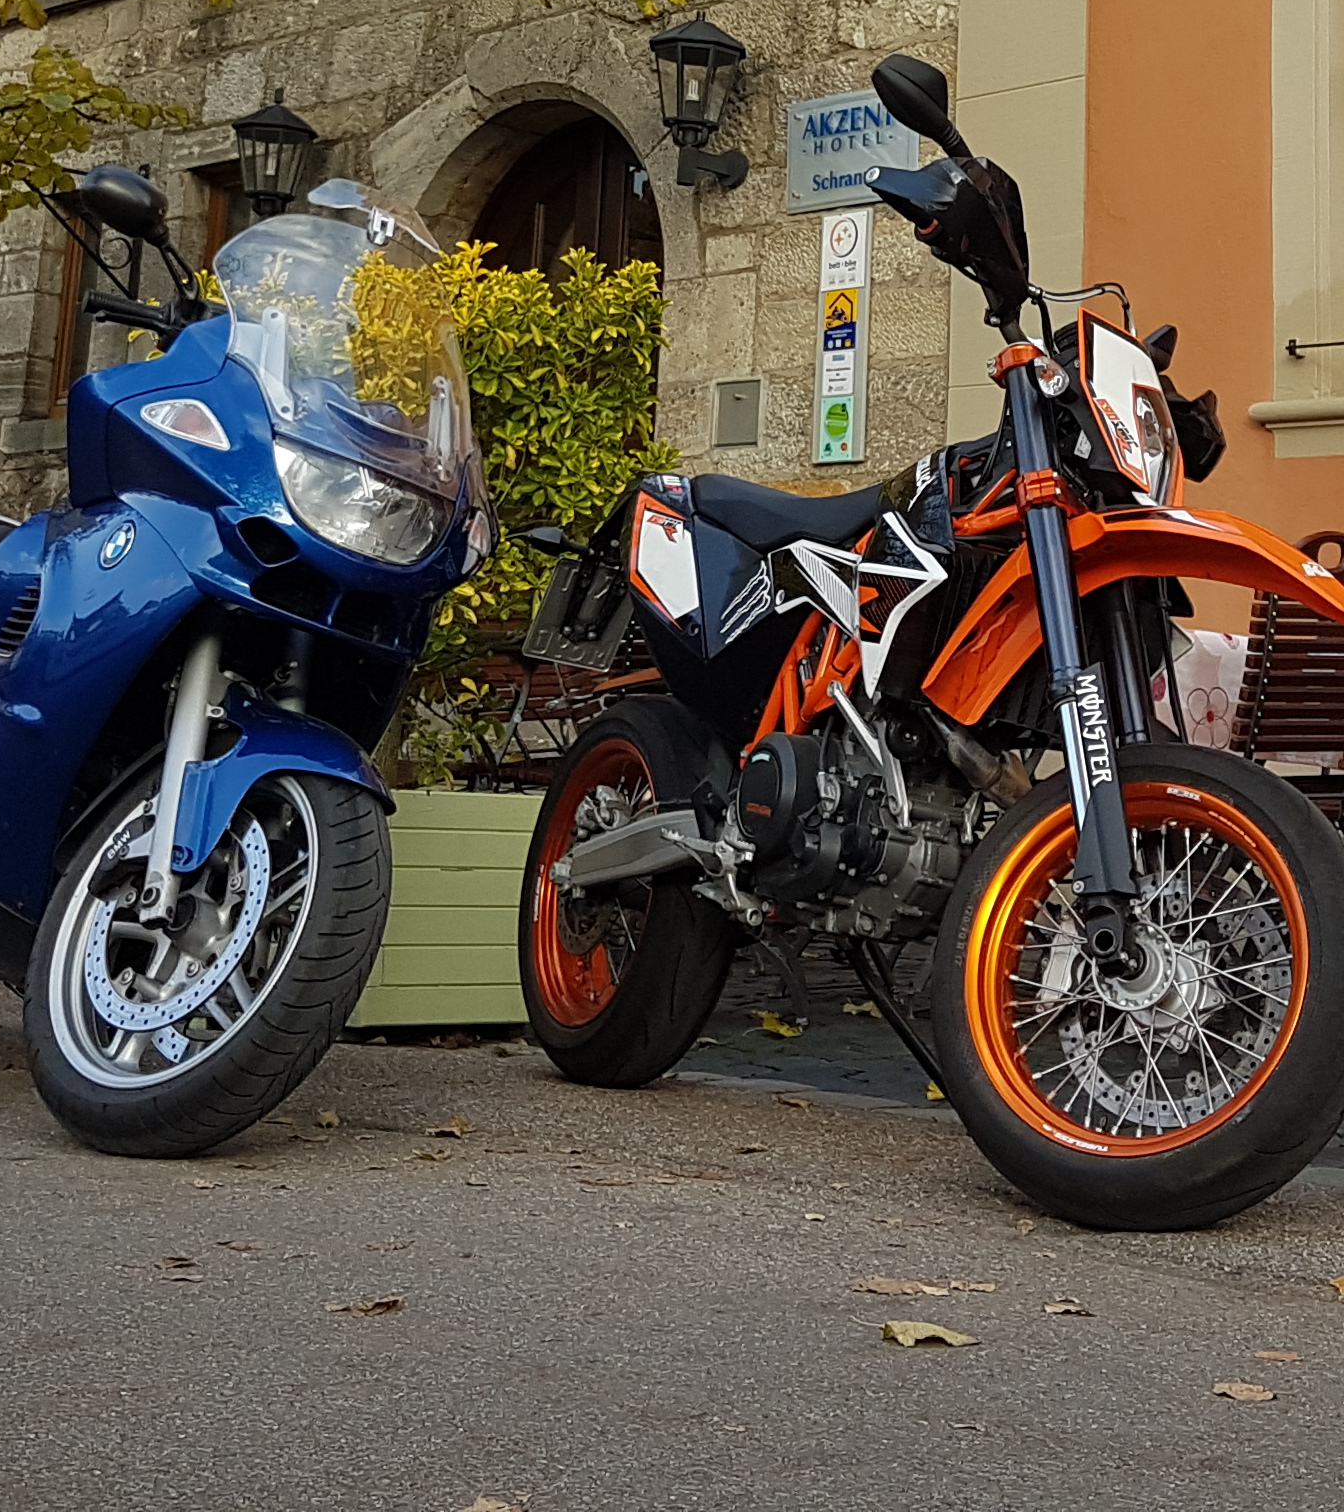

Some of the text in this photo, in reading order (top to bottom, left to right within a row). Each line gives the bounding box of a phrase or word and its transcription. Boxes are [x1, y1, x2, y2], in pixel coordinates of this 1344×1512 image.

[812, 170, 867, 192] Schran
[1075, 674, 1113, 787] MONSTER
[106, 829, 131, 859] BMW
